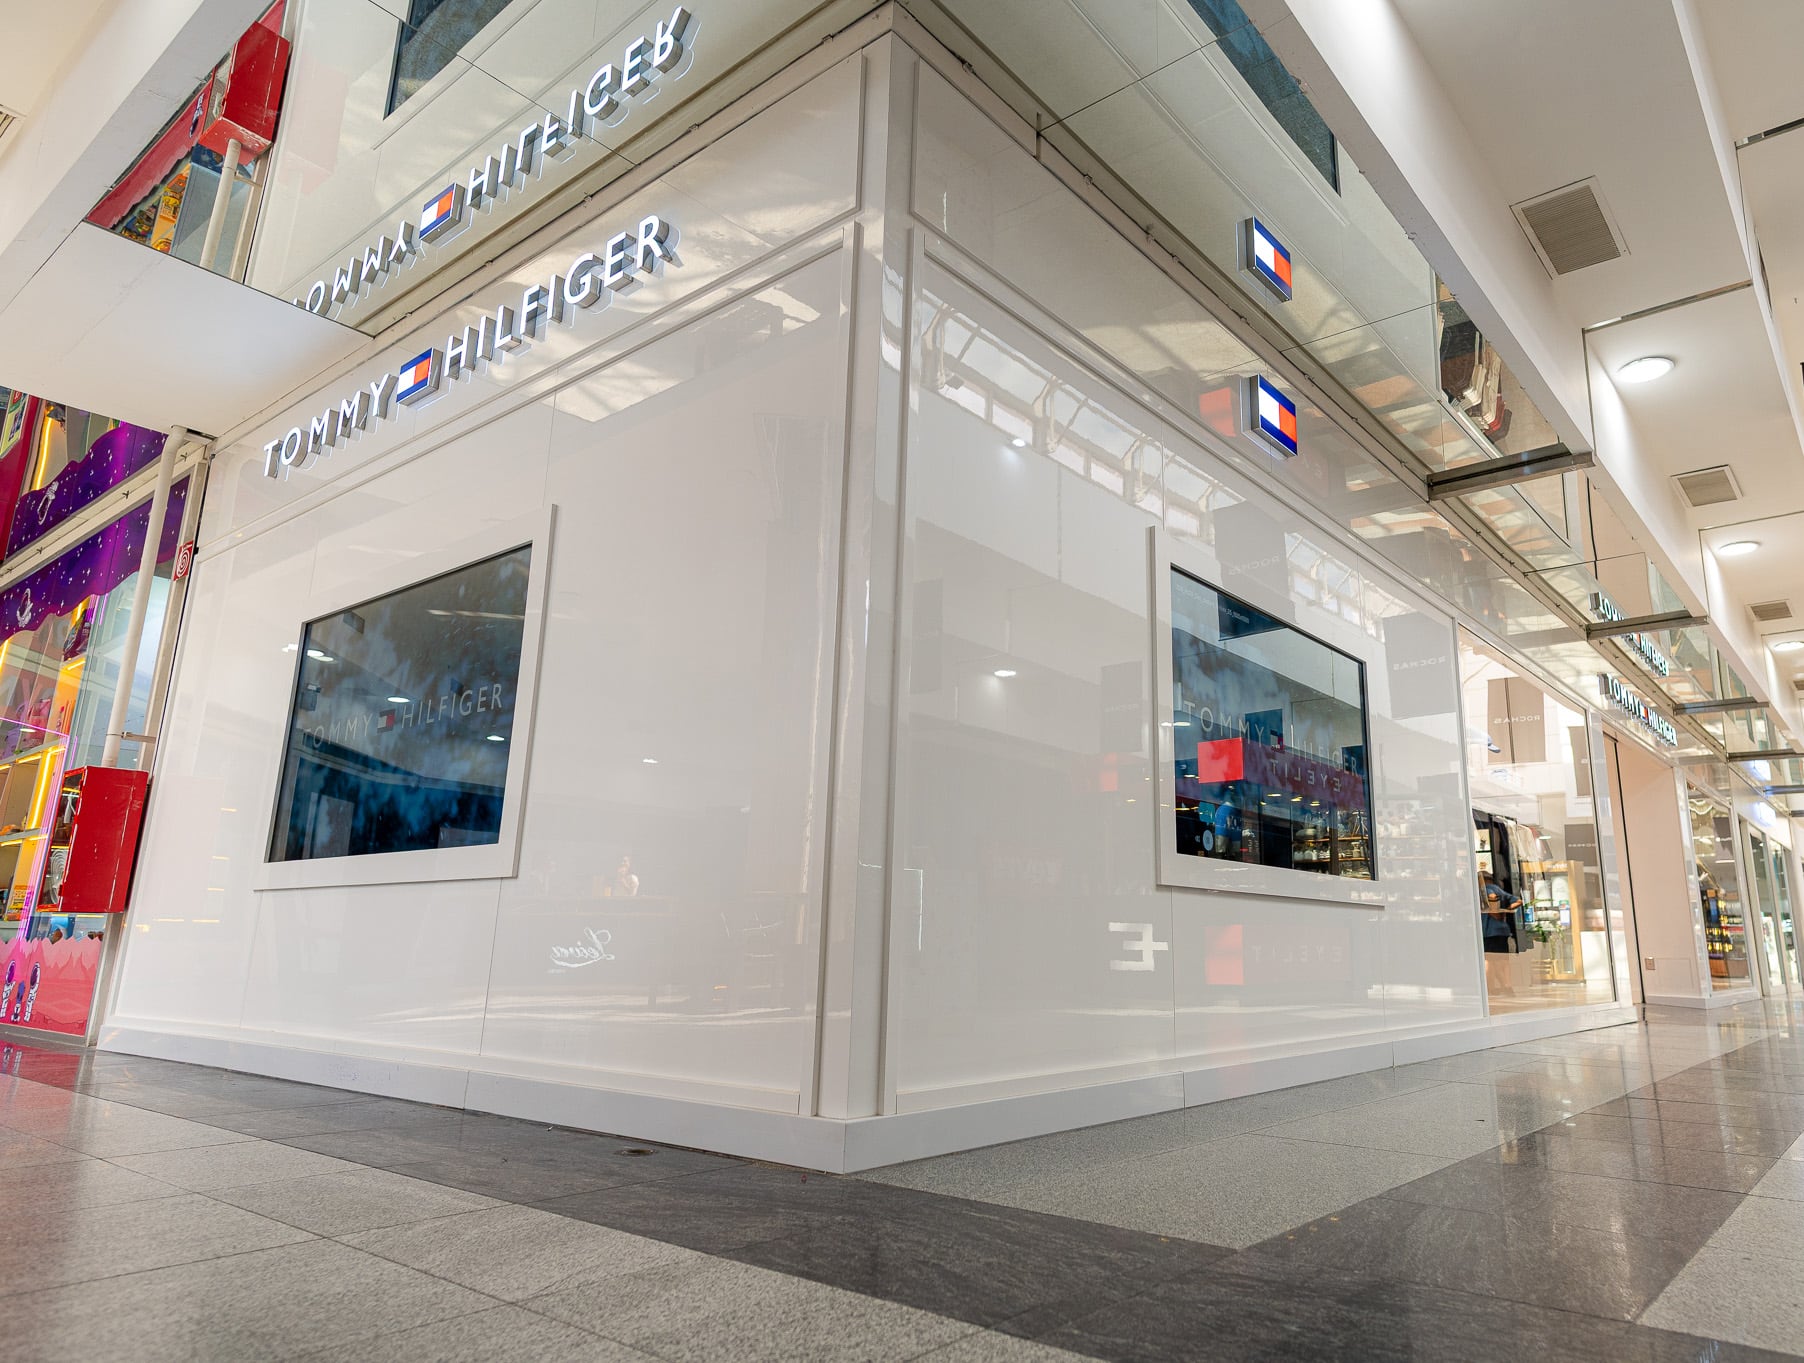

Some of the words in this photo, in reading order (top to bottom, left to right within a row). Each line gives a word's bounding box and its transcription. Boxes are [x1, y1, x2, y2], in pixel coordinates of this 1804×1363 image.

[264, 373, 392, 477] TOMMY
[444, 215, 673, 376] HILFIGER
[303, 713, 373, 748] TOMMY
[401, 684, 502, 729] HILFIGER
[1184, 700, 1265, 747] TOMMY
[1607, 673, 1640, 715] TOMMY
[1648, 707, 1678, 746] HILFIGER
